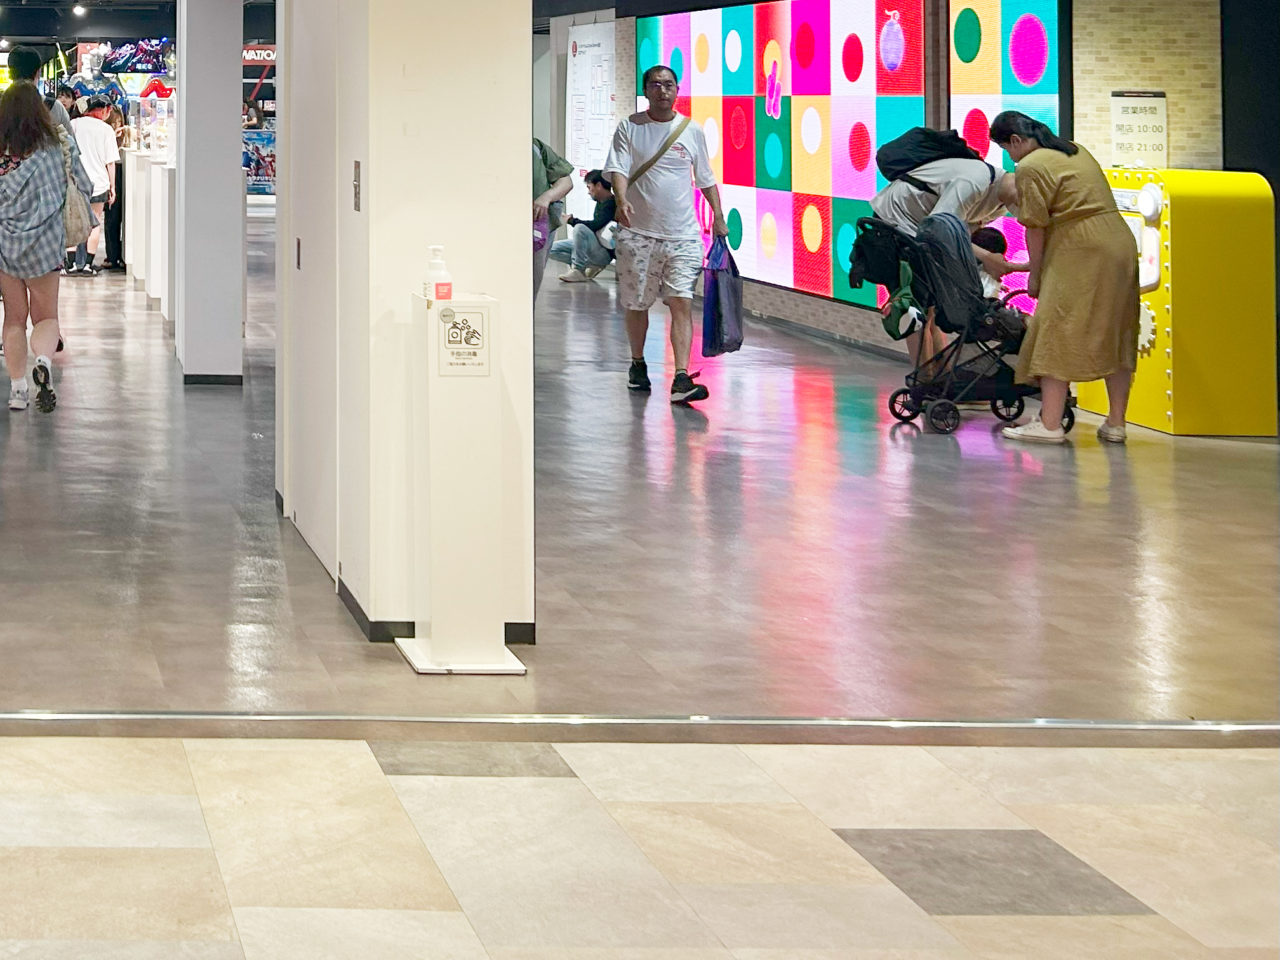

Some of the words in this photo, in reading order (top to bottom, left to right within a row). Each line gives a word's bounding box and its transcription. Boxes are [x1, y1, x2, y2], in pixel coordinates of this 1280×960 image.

[1121, 106, 1157, 115] 営業時間
[1137, 124, 1164, 133] 10:00
[1137, 143, 1164, 152] 21:00
